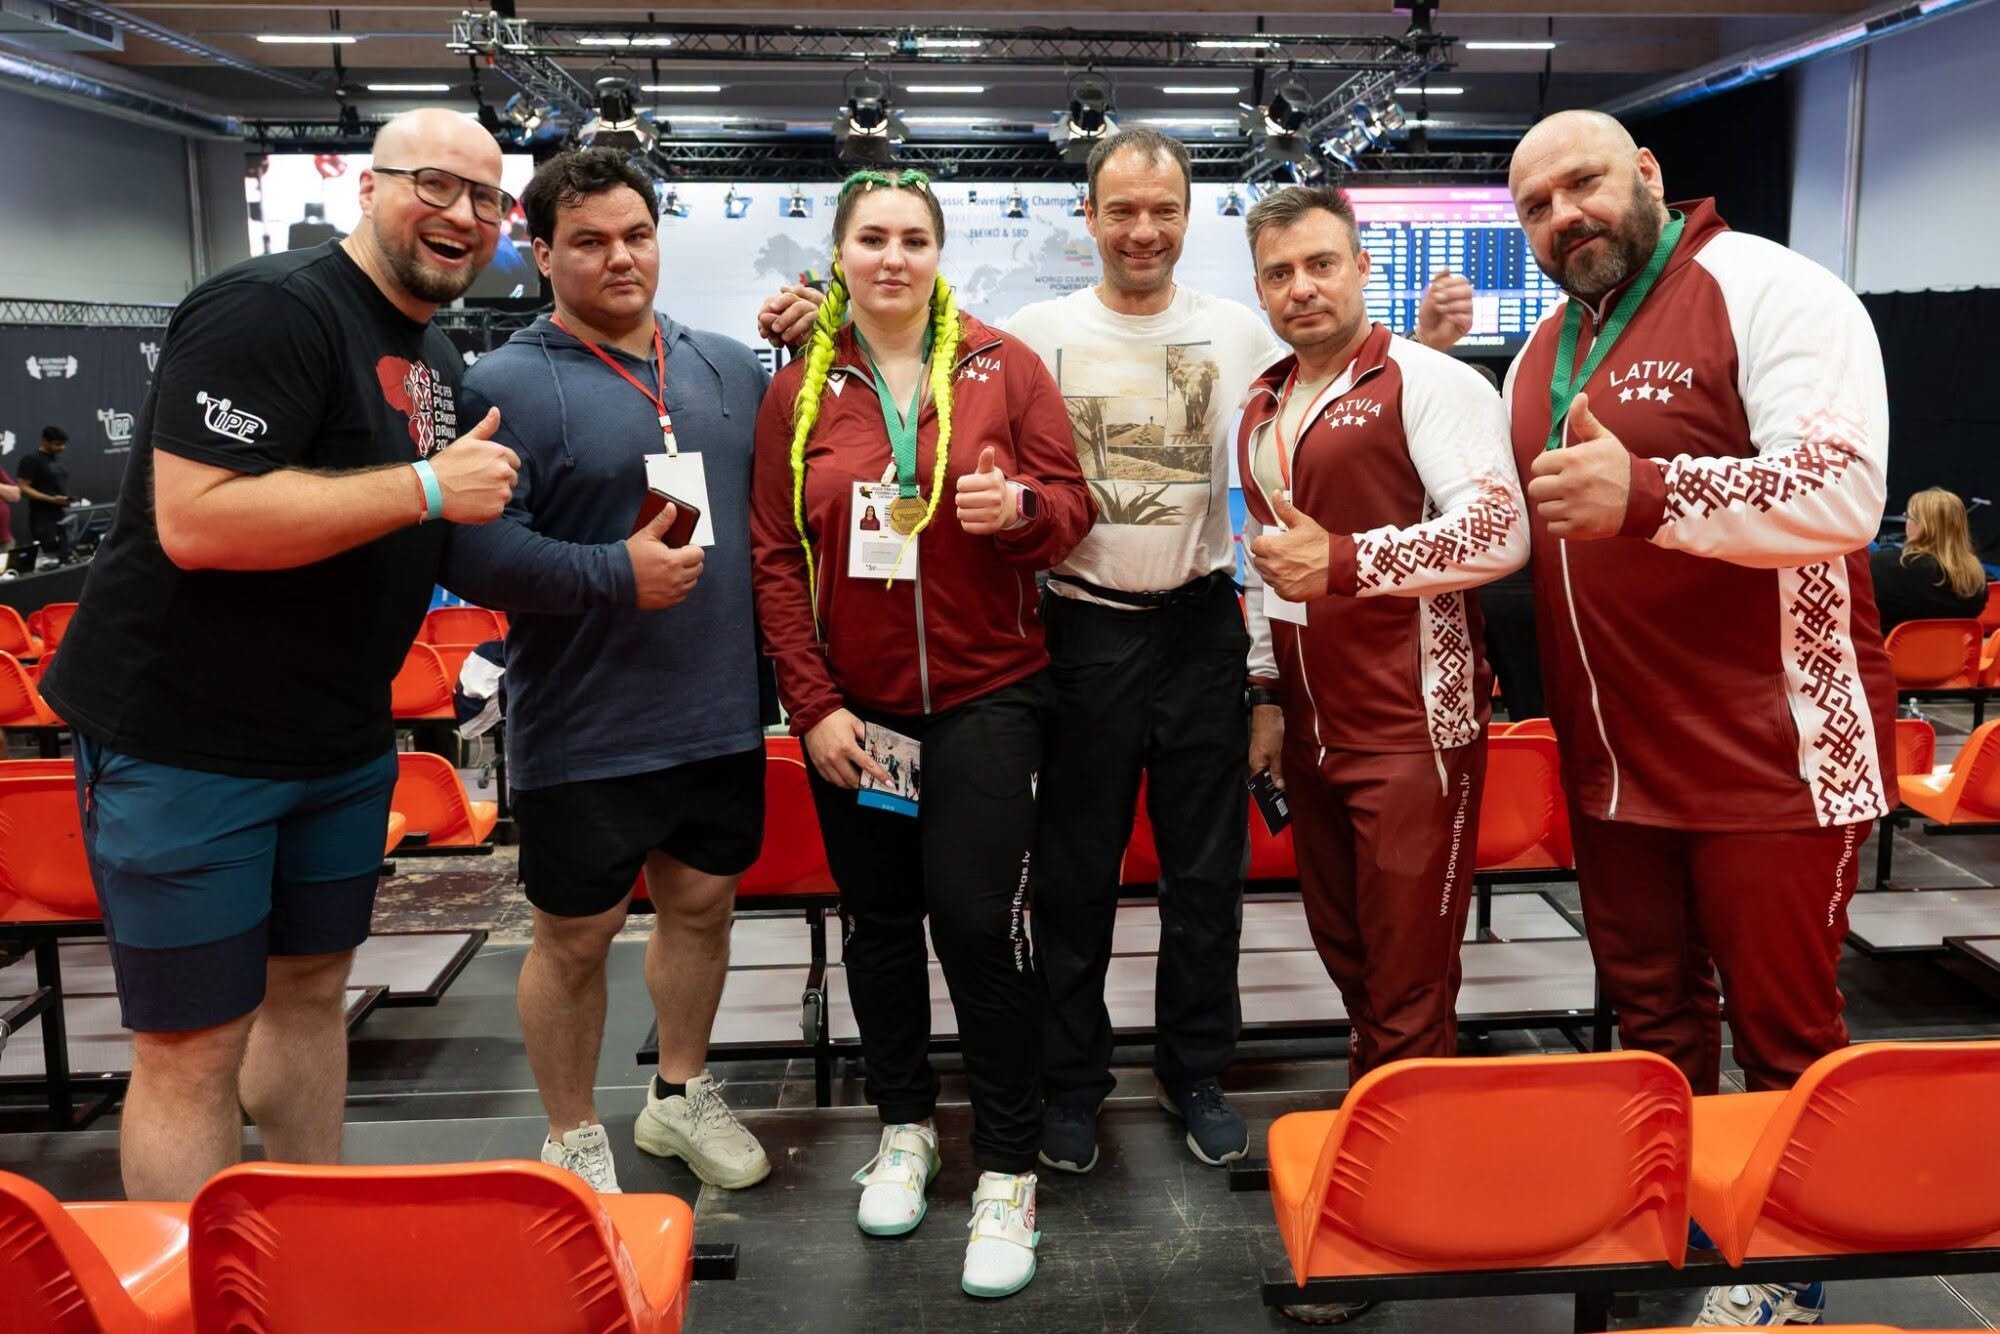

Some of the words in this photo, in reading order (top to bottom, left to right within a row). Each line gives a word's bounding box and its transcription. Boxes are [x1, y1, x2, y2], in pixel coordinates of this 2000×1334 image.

[1610, 361, 1694, 389] LATVIA
[1324, 398, 1382, 420] LATVIA
[213, 411, 259, 437] IPF
